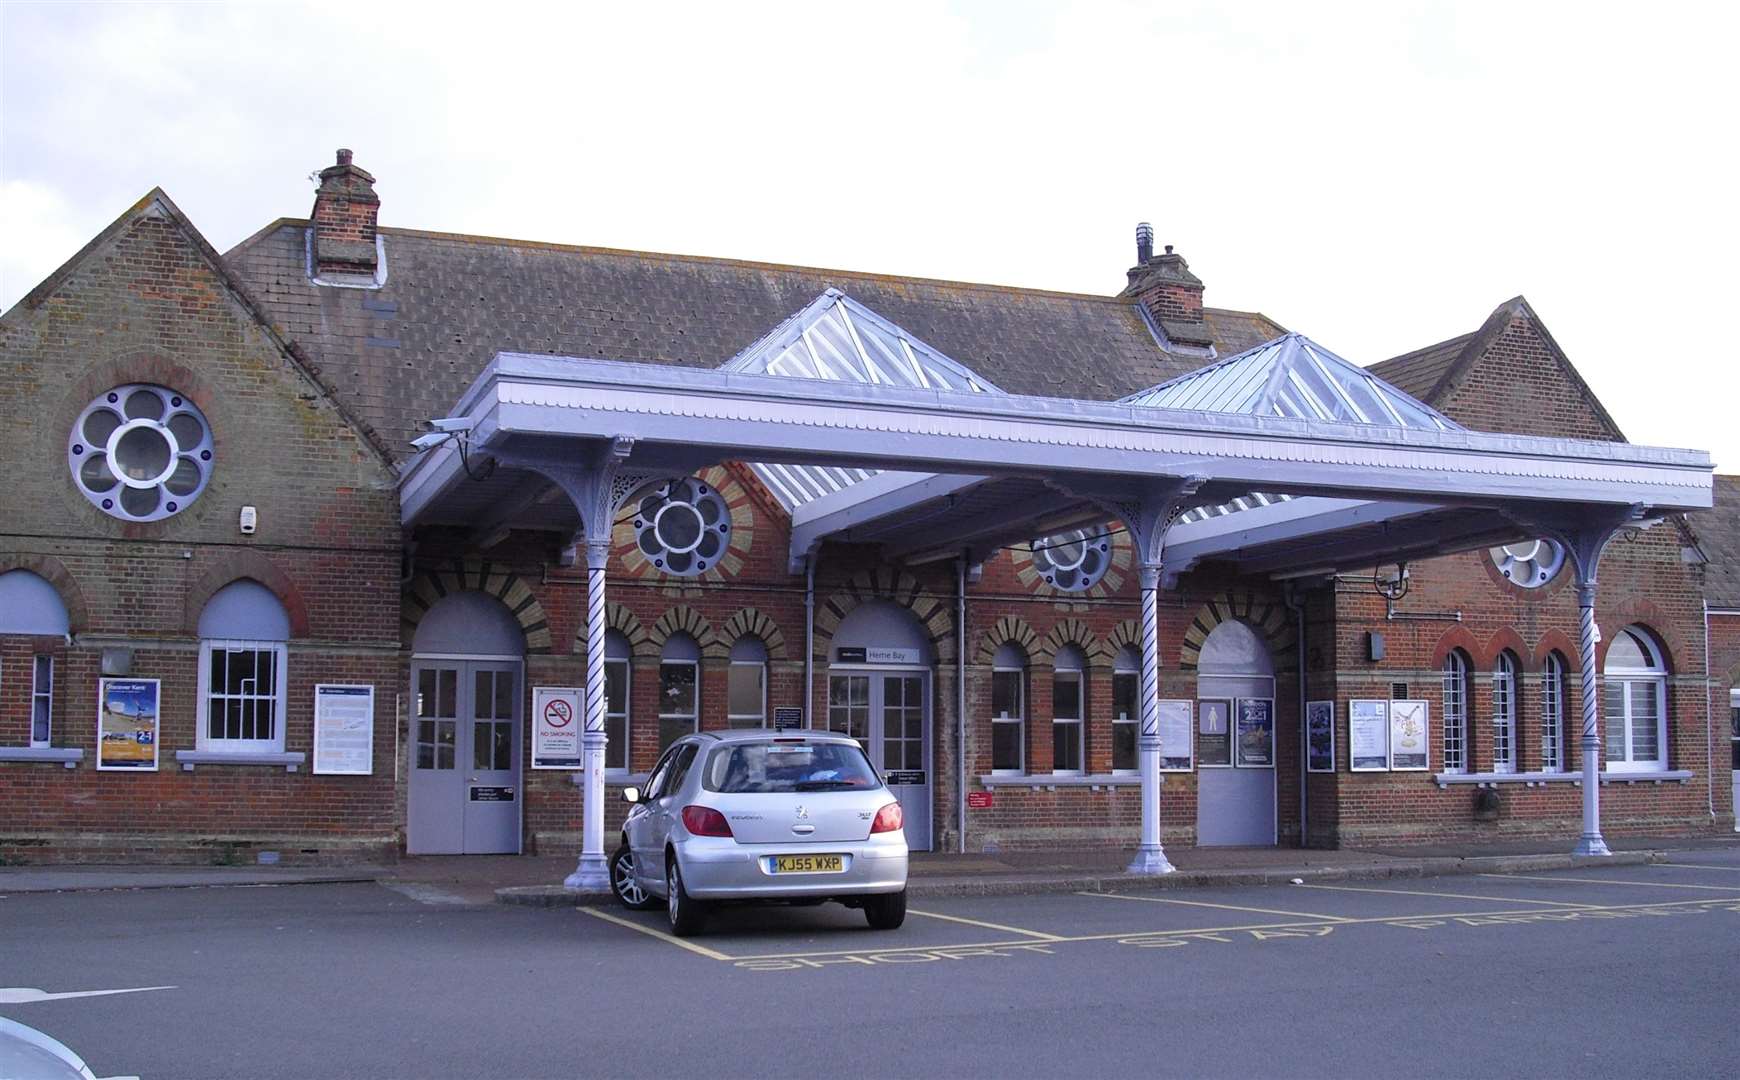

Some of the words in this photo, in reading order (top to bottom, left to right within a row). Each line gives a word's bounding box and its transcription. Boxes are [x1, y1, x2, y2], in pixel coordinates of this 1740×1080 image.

[869, 651, 891, 659] Herne
[892, 651, 906, 661] Bay
[778, 858, 813, 871] KJ55
[815, 857, 840, 869] WXP
[734, 944, 1056, 971] SHORT
[1117, 926, 1334, 948] STAY
